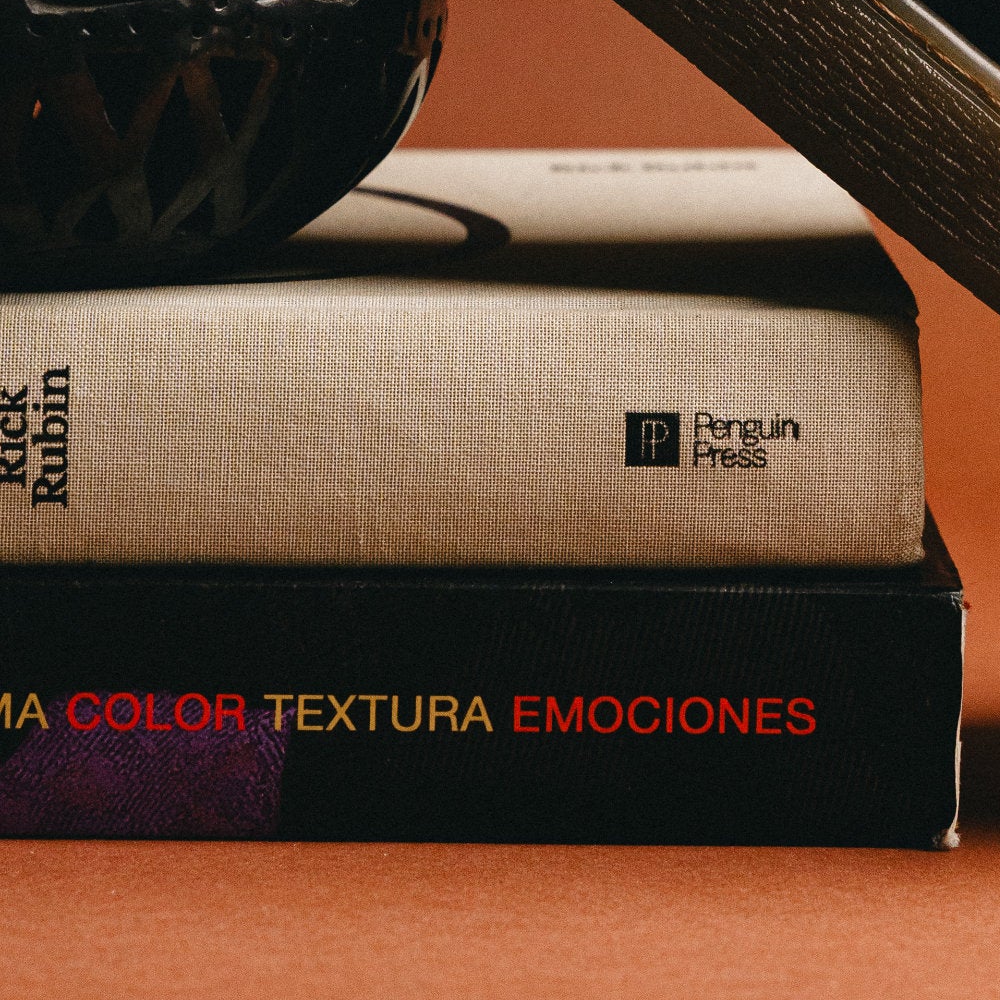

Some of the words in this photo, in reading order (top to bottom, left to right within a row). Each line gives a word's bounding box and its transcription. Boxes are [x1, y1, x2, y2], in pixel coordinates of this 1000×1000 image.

[0, 385, 27, 488] Rick
[32, 365, 69, 508] Rubin
[693, 412, 799, 446] Penguin
[692, 440, 767, 468] Press
[66, 692, 246, 731] COLOR
[263, 694, 493, 732] TEXTURA
[513, 696, 817, 735] EMOCIONES
